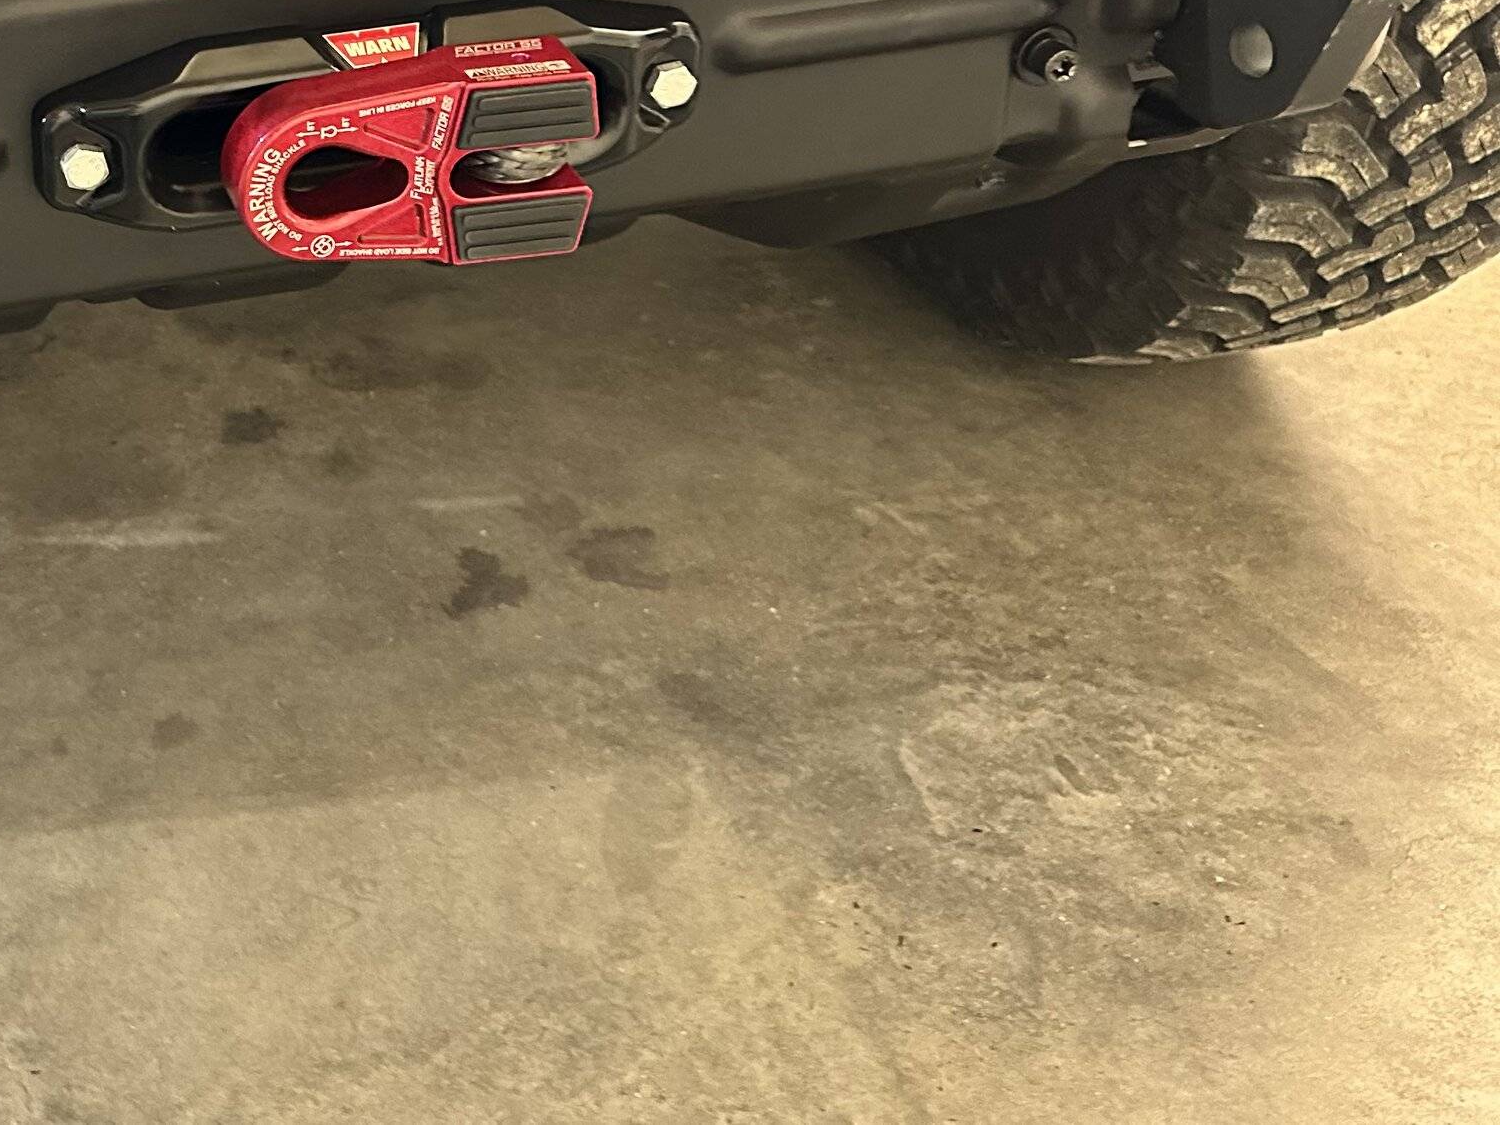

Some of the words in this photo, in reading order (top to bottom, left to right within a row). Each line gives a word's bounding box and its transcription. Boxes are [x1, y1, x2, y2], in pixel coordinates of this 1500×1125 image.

[343, 35, 411, 57] WARN
[455, 40, 517, 57] FACTOR
[483, 63, 548, 77] WARNING
[431, 111, 449, 151] FACTOR
[274, 139, 307, 174] SHACKLE
[249, 148, 282, 242] WARNING
[264, 175, 276, 200] LOAD
[273, 219, 290, 237] NOT
[288, 230, 303, 242] DO
